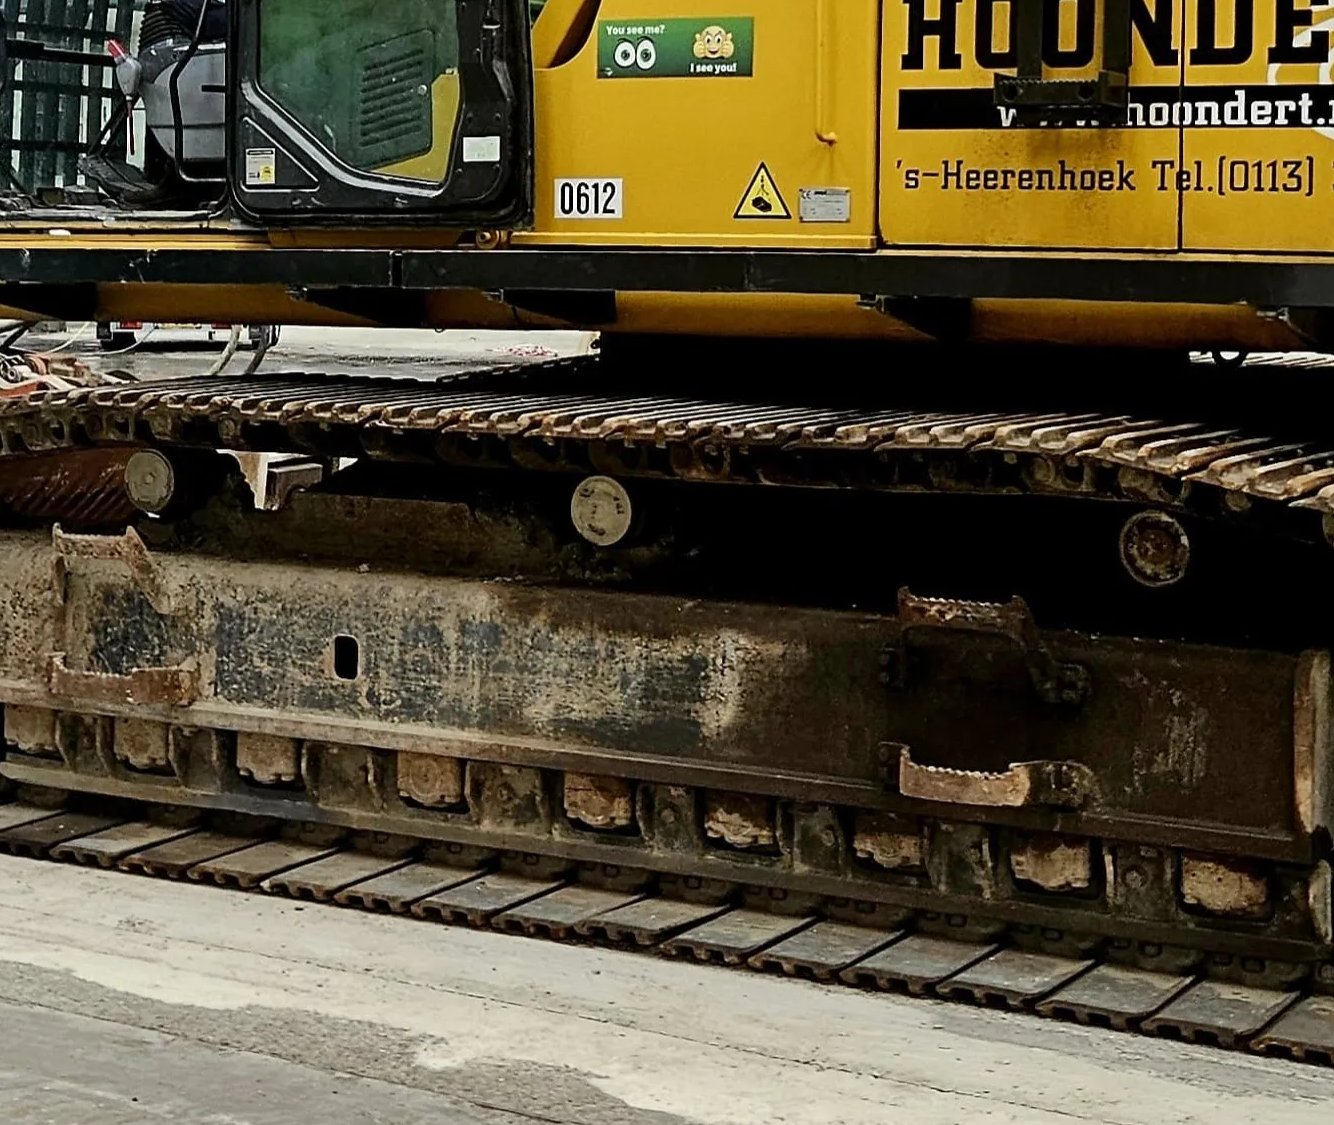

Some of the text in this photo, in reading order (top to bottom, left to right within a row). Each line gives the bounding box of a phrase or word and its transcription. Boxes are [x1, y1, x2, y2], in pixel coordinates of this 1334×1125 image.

[606, 25, 665, 35] You see me?
[695, 64, 713, 72] see
[713, 63, 737, 74] you!
[895, 159, 1136, 192] 's-Heerenhoek
[560, 181, 616, 216] 0612
